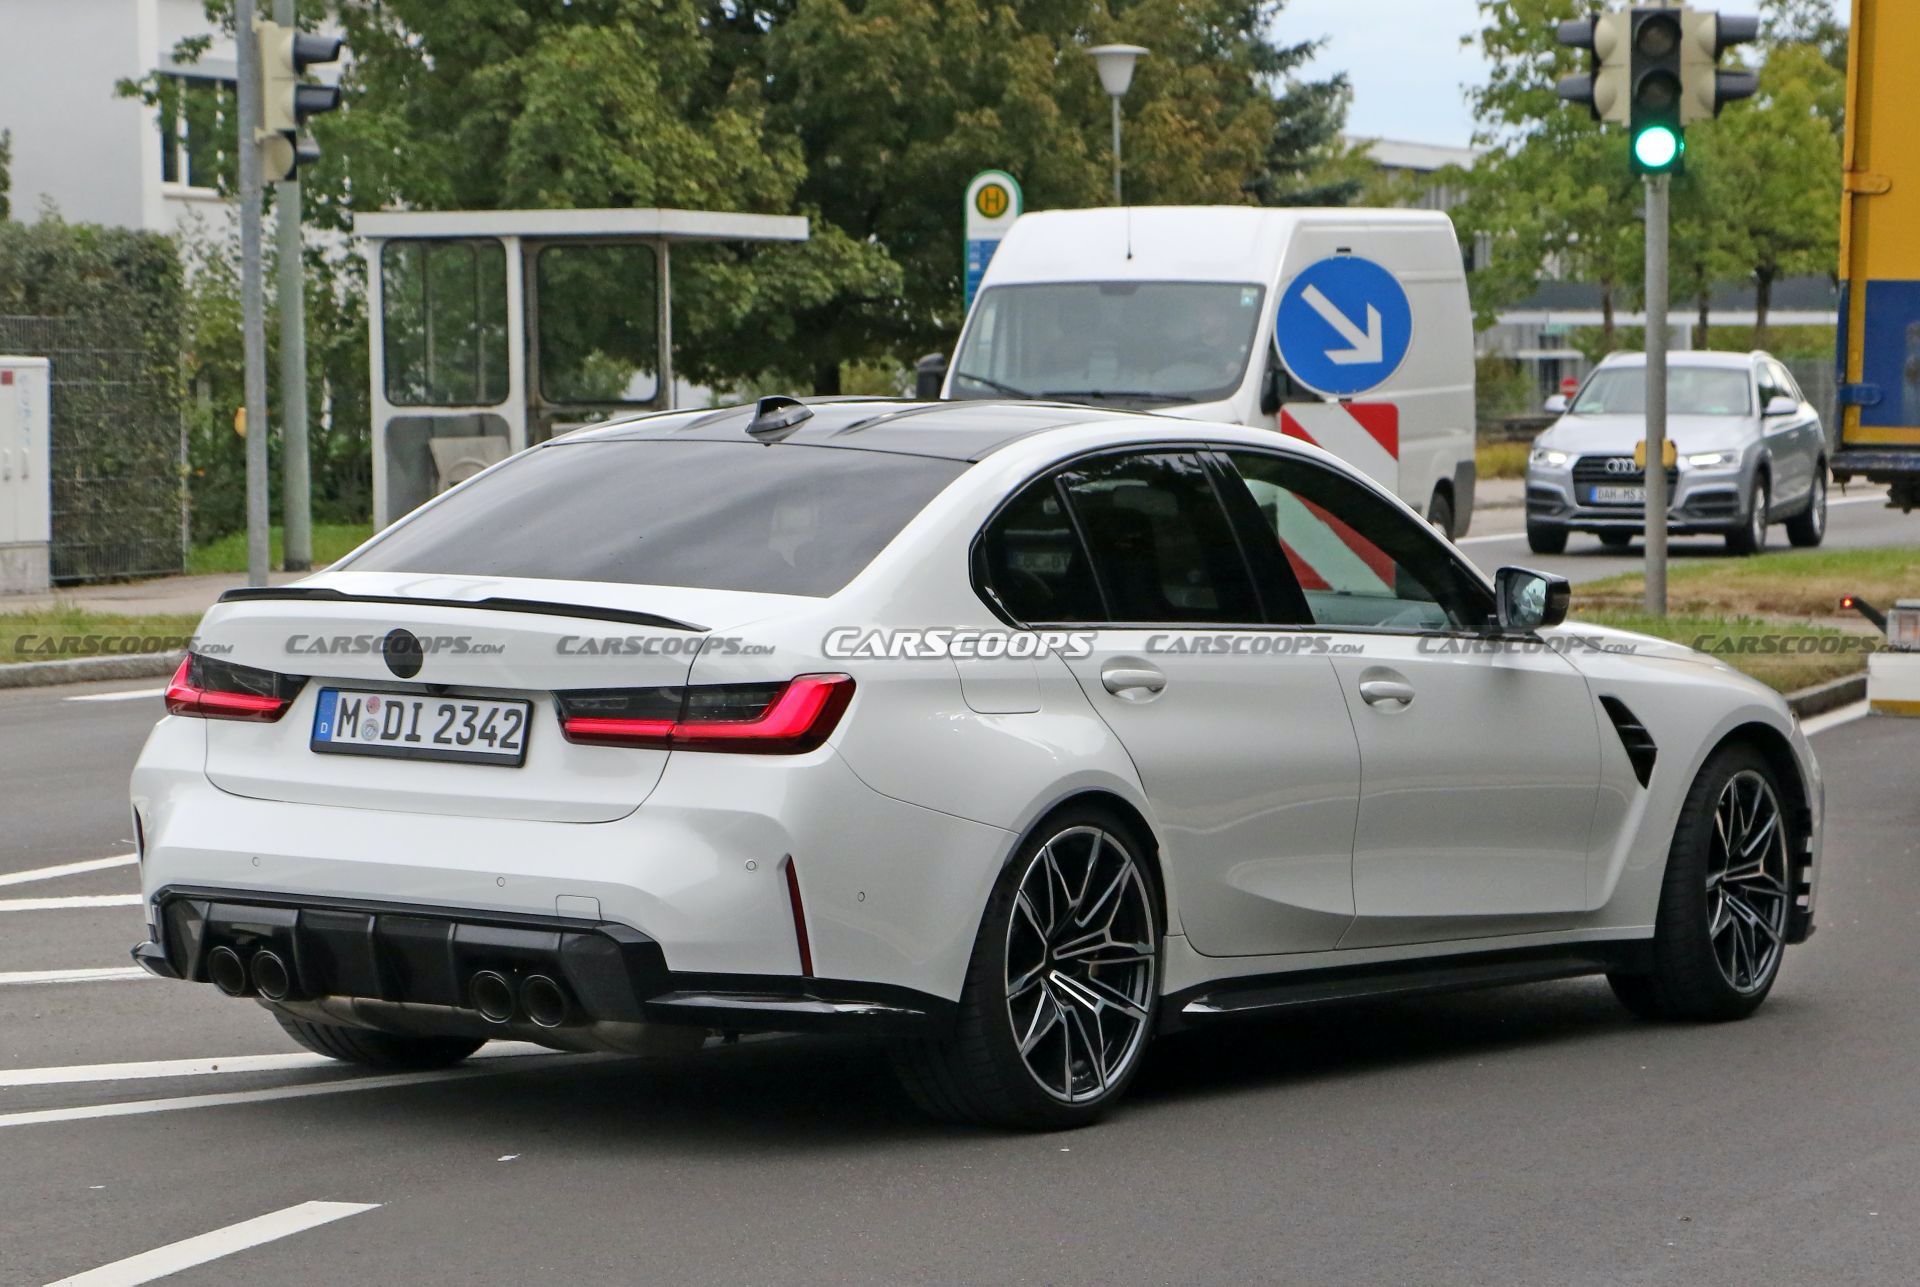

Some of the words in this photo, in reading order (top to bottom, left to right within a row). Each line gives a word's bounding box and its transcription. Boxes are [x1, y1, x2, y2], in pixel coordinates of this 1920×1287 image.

[985, 189, 999, 211] H
[320, 722, 328, 734] D
[336, 697, 362, 738] M
[380, 700, 423, 742] DI
[433, 704, 523, 749] 2342
